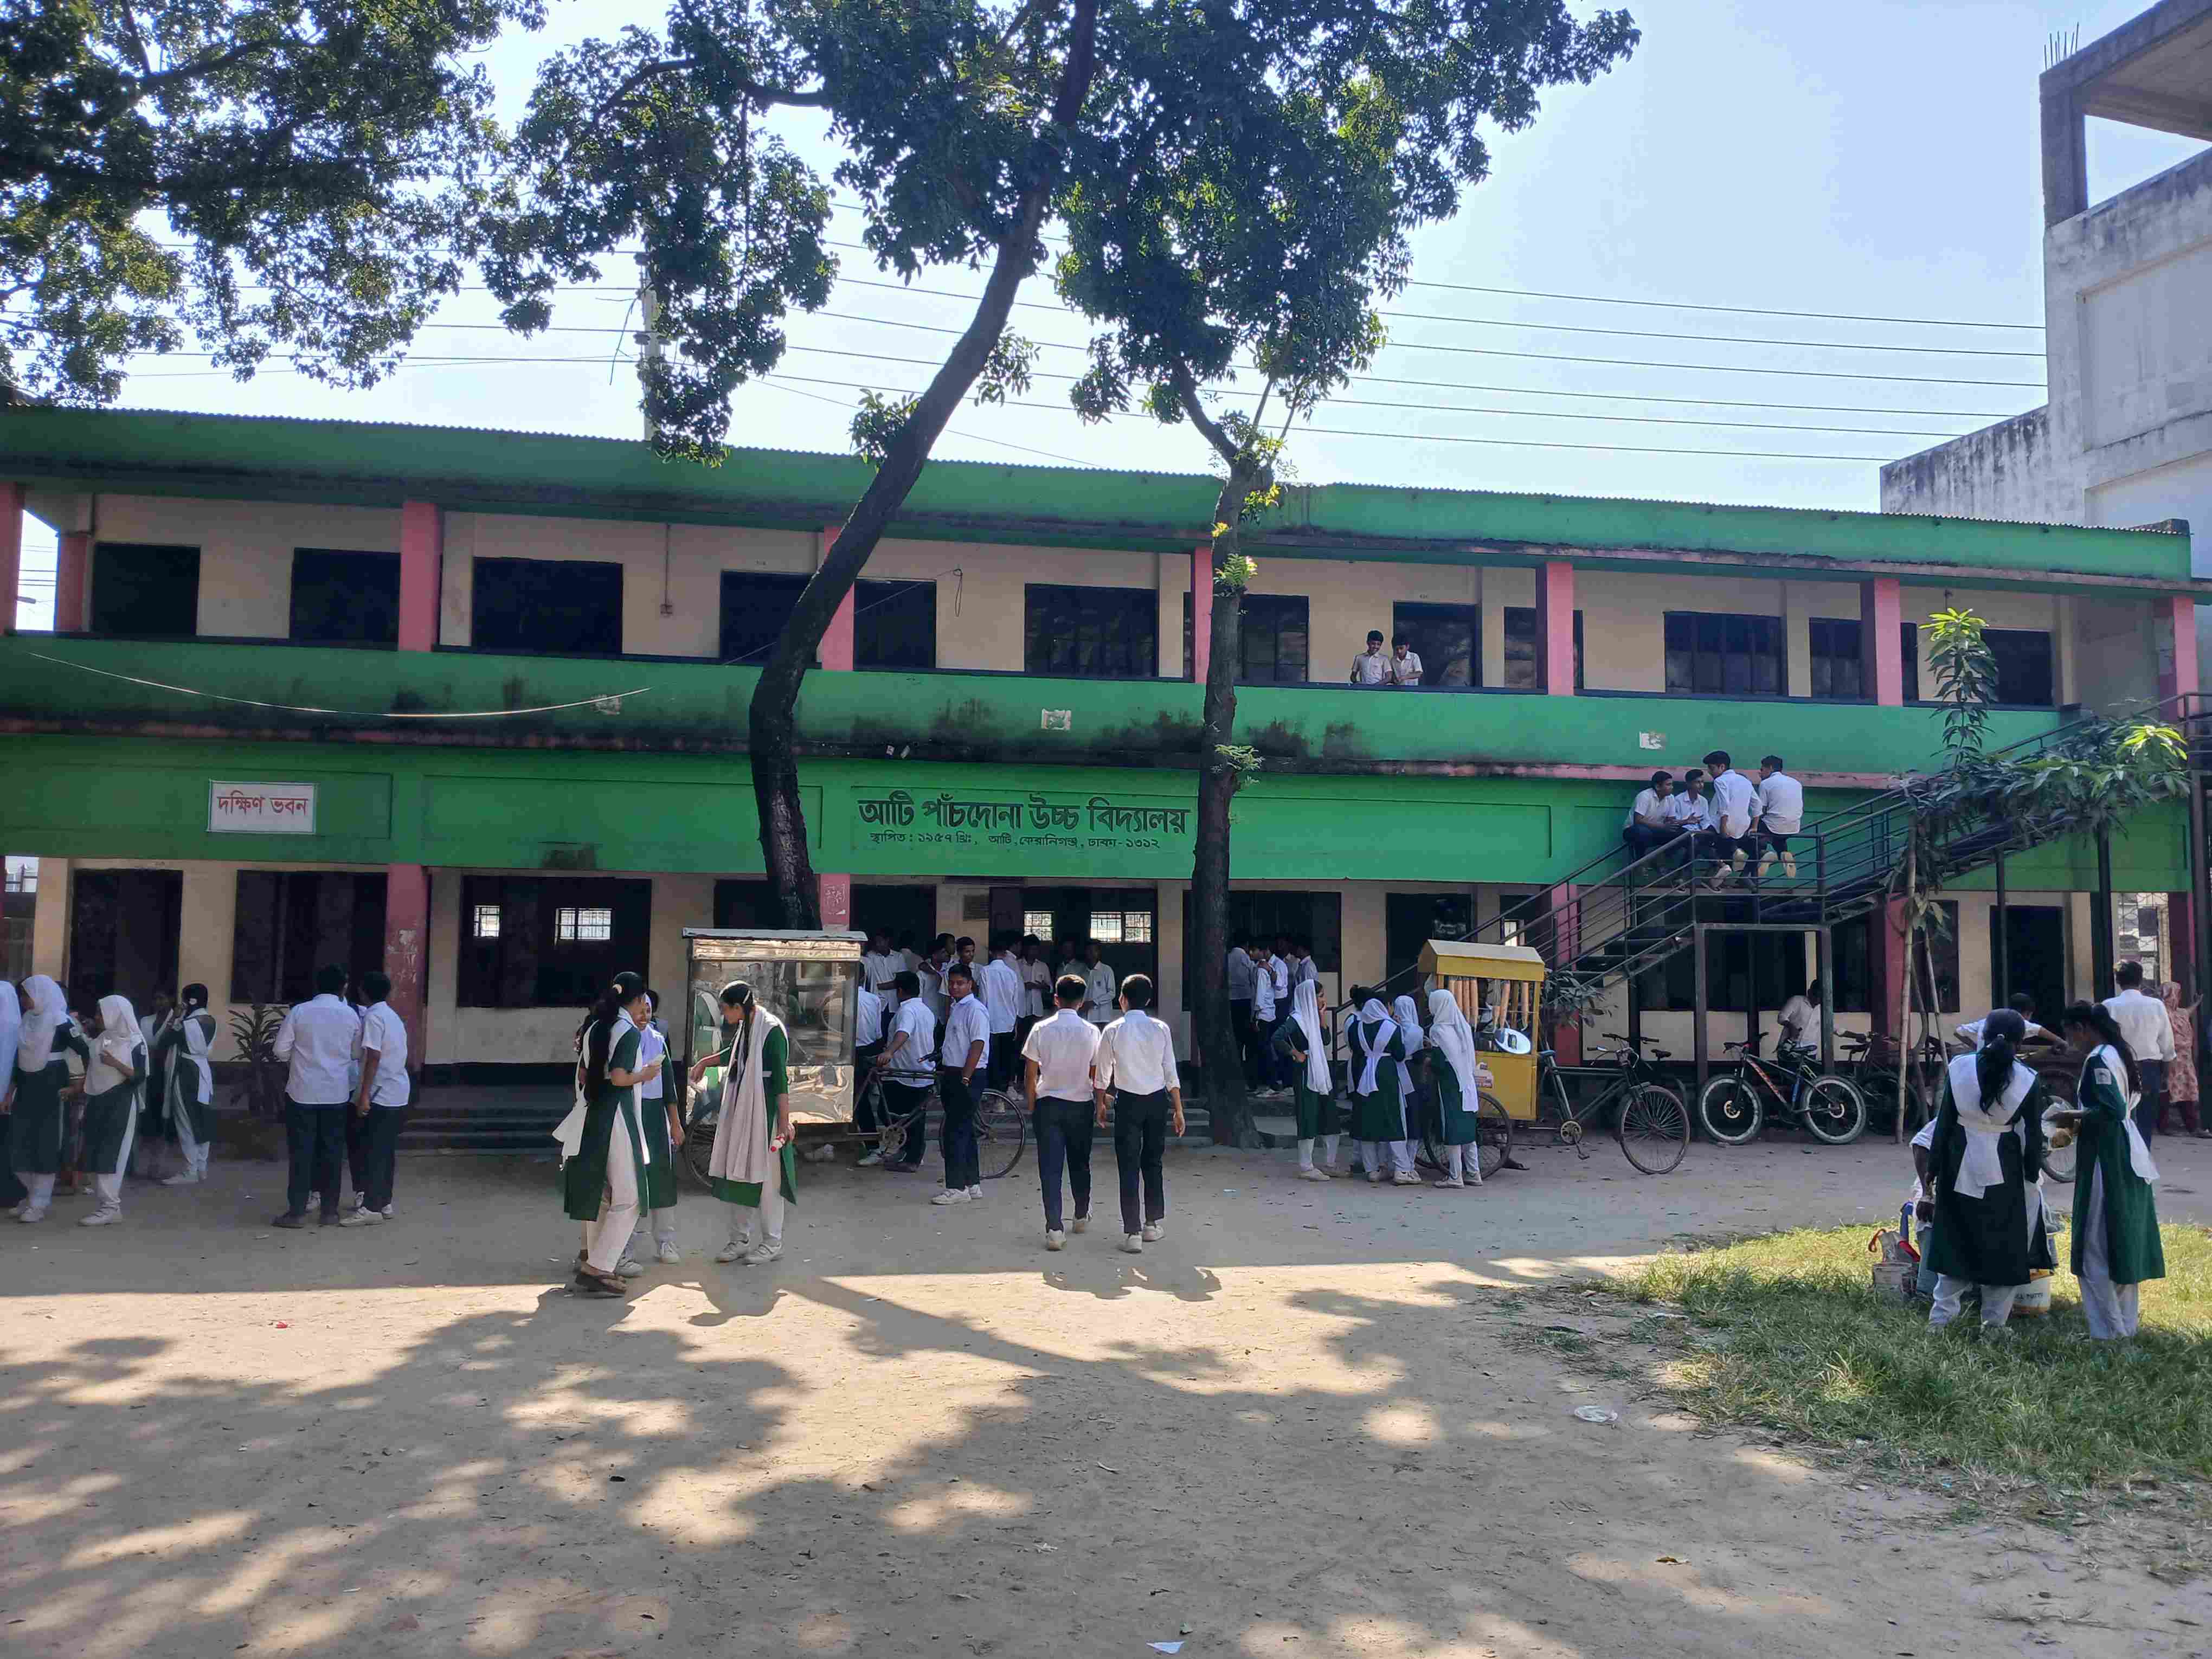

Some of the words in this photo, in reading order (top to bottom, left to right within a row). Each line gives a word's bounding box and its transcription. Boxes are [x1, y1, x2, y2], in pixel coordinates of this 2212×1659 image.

[216, 790, 265, 814] দক্ষিণ
[269, 798, 309, 815] ভবন
[857, 790, 915, 826] আটি
[921, 793, 1024, 829] পাঁচদোনা
[1027, 793, 1081, 830] উচ্চ
[1085, 796, 1191, 834] বিদ্যালয়
